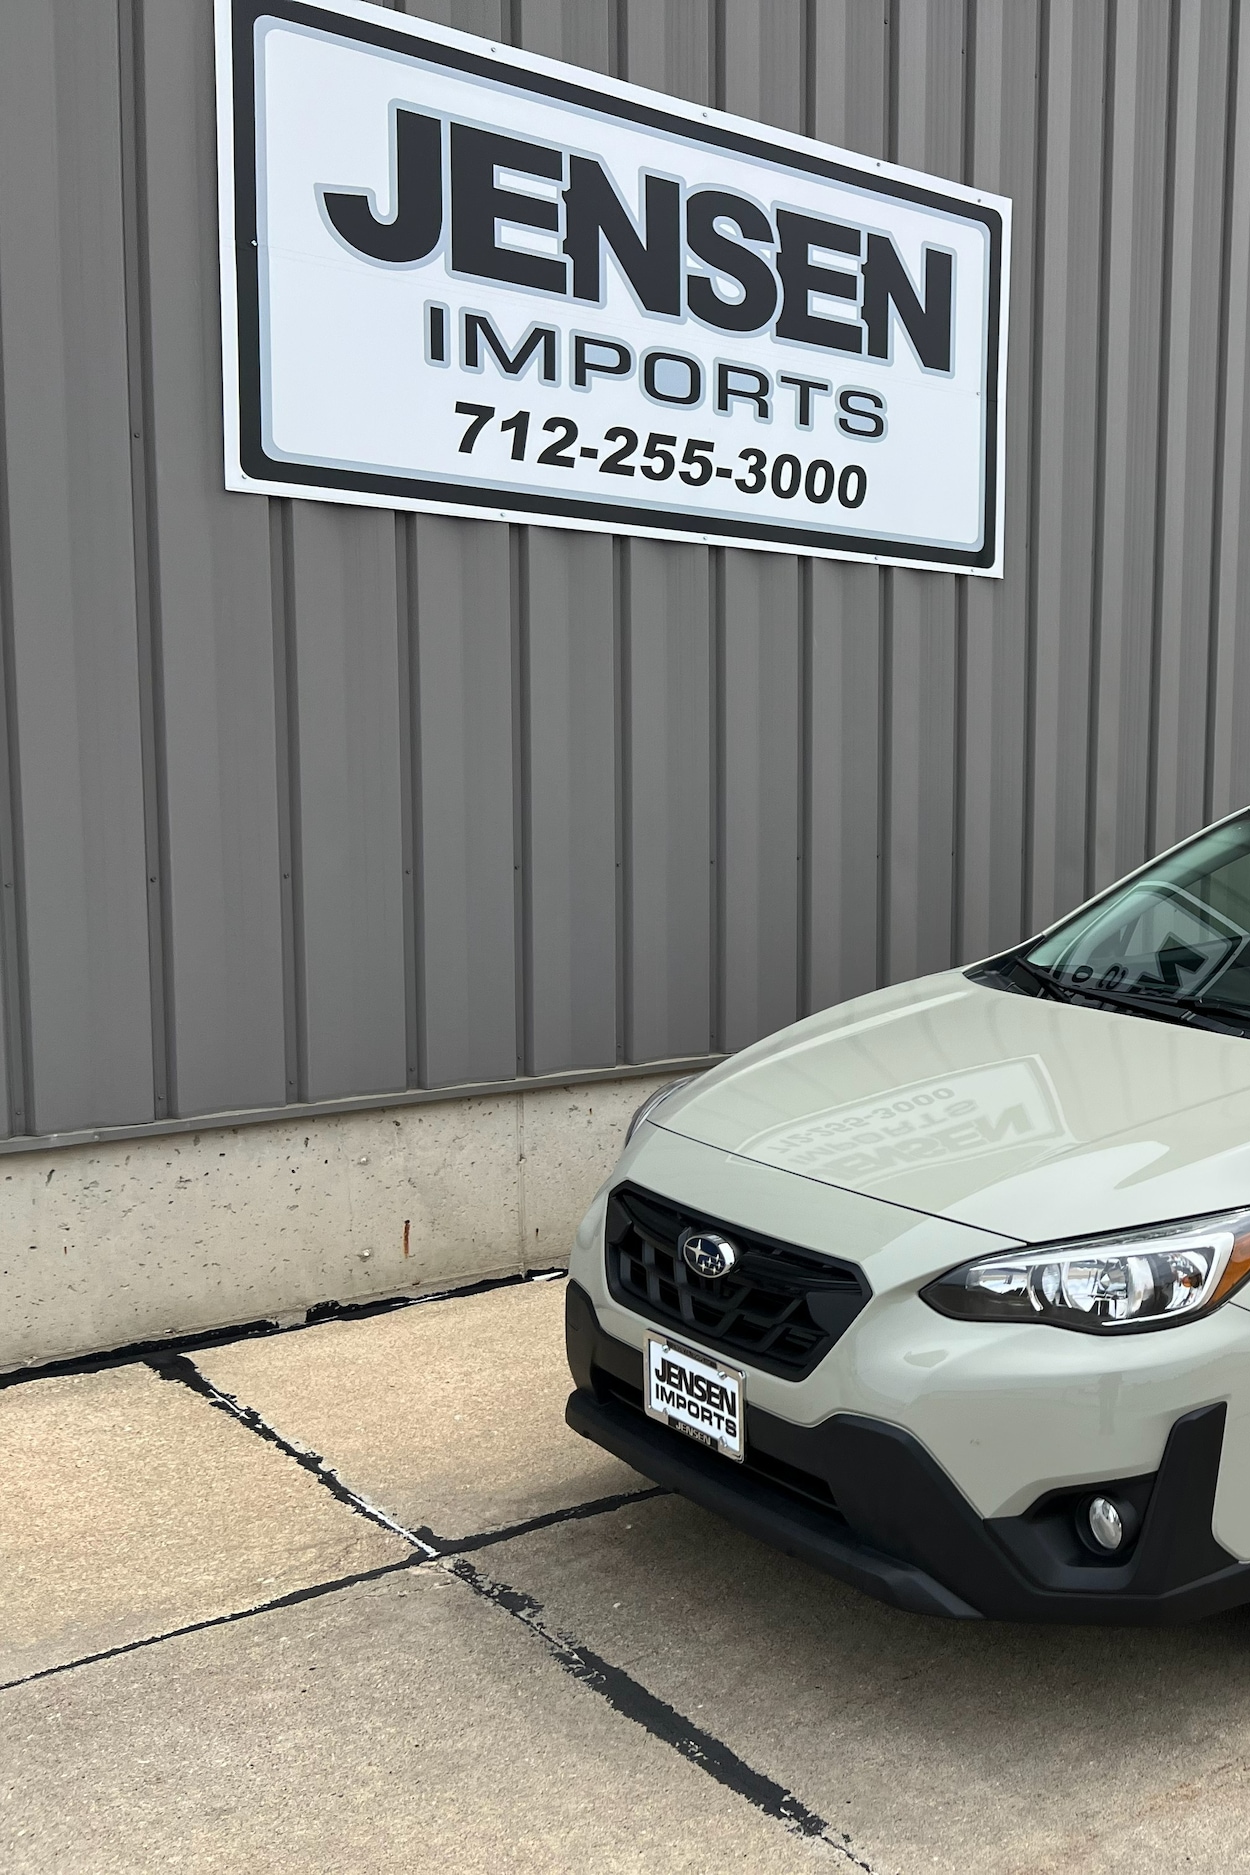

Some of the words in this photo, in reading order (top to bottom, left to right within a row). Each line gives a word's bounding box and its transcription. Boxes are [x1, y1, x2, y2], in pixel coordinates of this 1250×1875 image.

[320, 104, 955, 375] JENSEN
[427, 304, 887, 439] IMPORTS
[454, 402, 868, 509] 712-255-3000
[654, 1357, 737, 1418] JENSEN
[655, 1383, 737, 1438] IMPORTS
[675, 1422, 711, 1447] JENSEN
